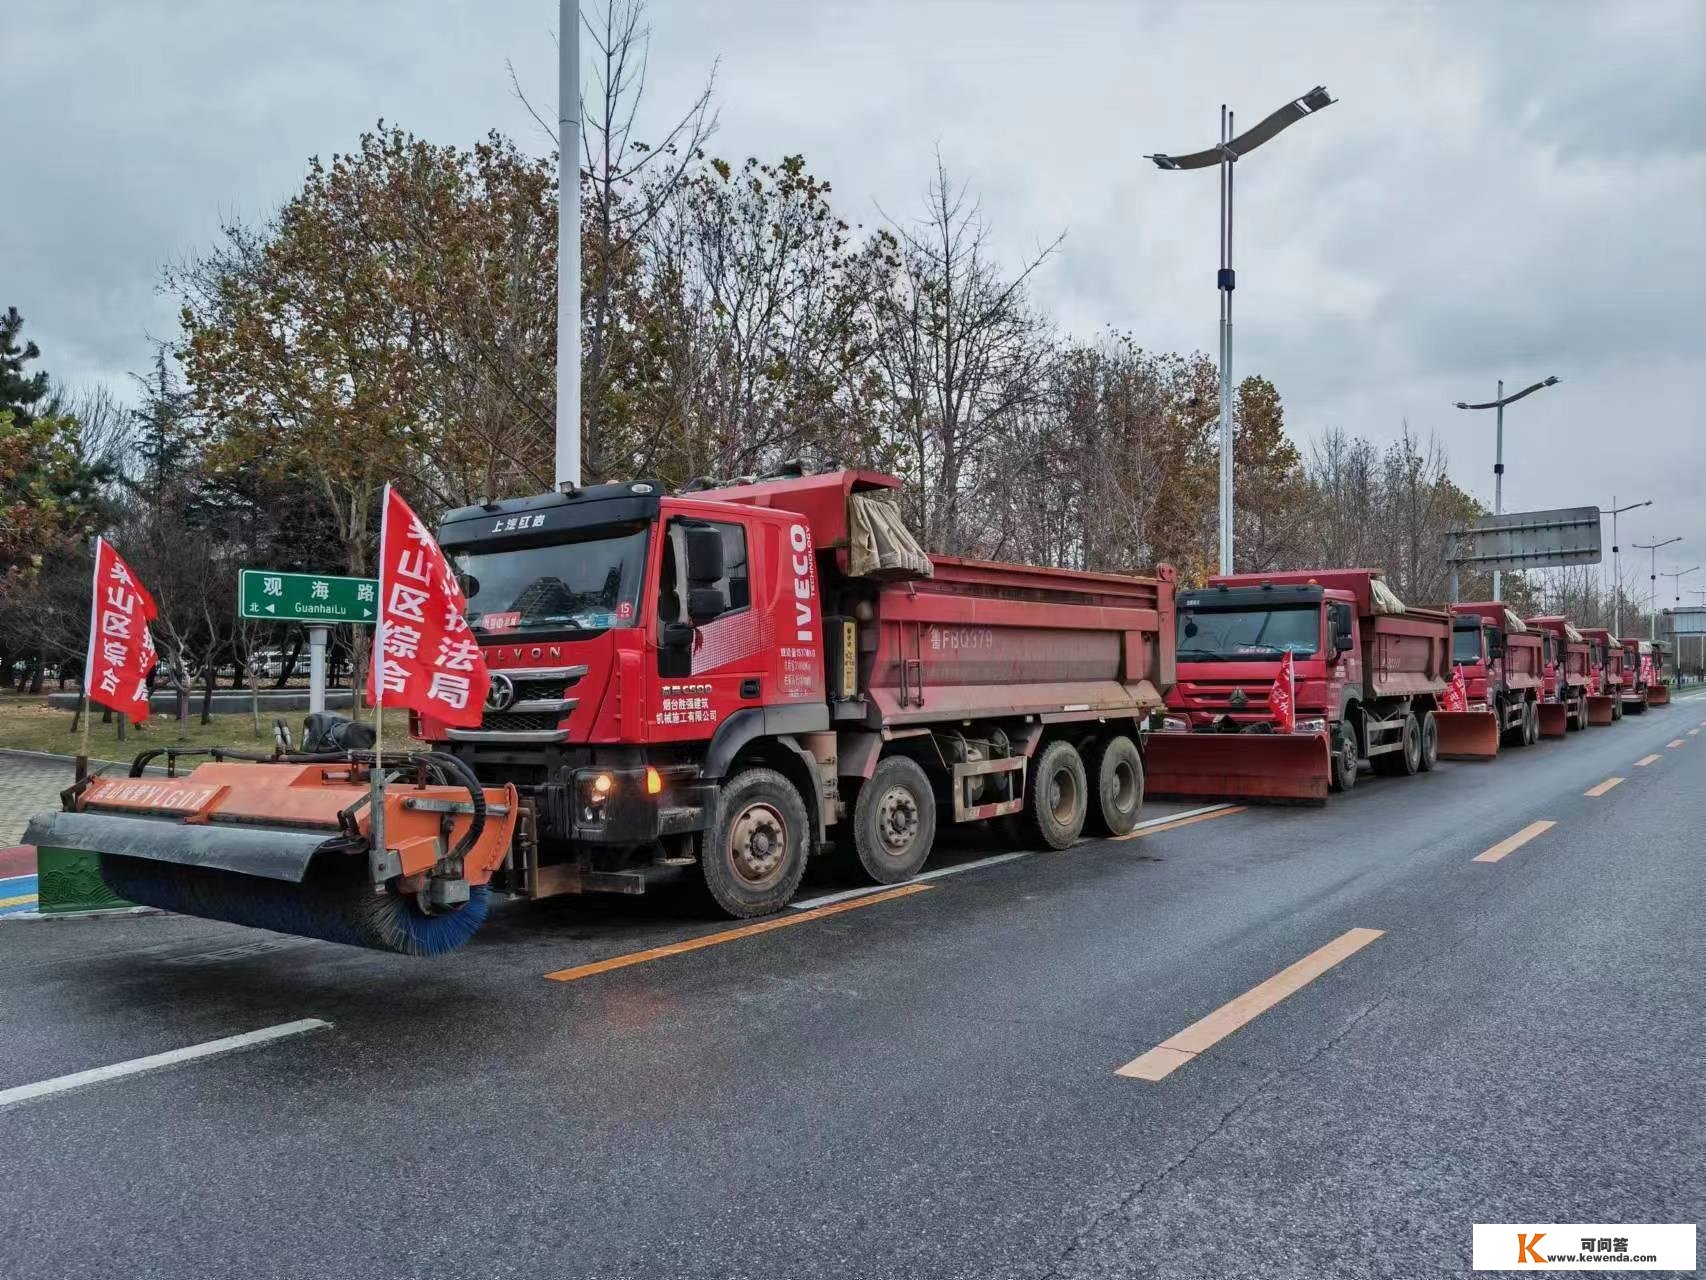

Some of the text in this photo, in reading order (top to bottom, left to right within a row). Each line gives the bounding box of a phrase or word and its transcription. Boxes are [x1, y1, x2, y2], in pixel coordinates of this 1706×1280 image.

[805, 525, 816, 597] TECHNOLOGY
[263, 577, 375, 602] 观海路
[790, 524, 813, 641] IVECO
[249, 602, 260, 613] 北
[295, 602, 347, 615] GuanhaiLu
[656, 709, 717, 725] 机械施工有限公司
